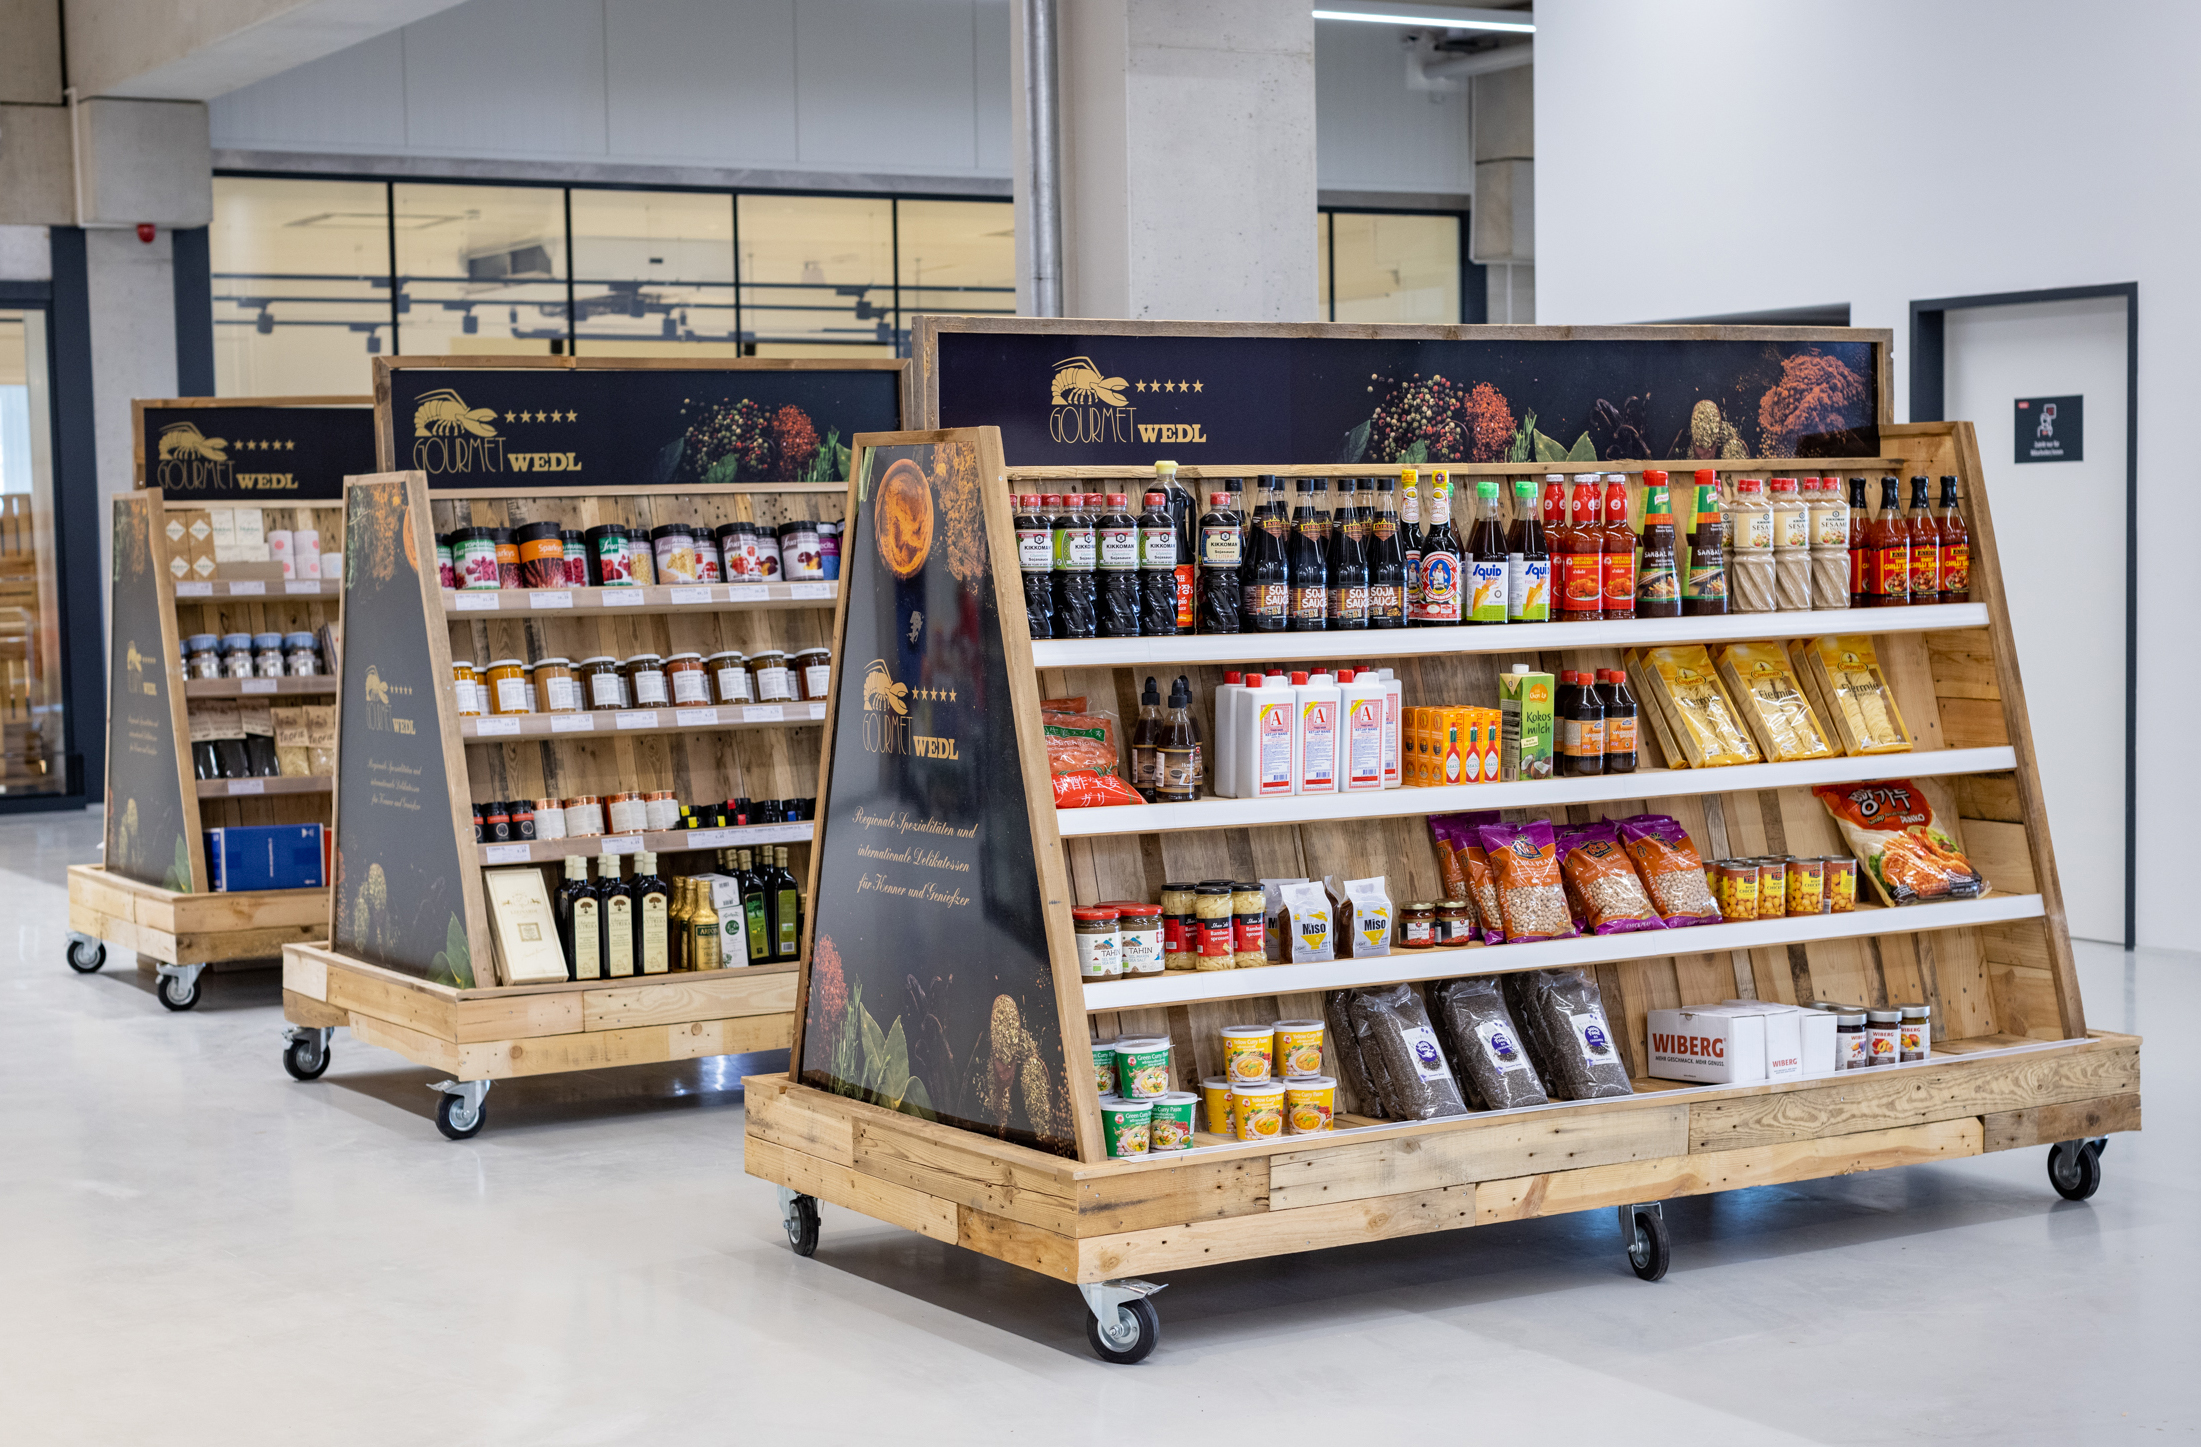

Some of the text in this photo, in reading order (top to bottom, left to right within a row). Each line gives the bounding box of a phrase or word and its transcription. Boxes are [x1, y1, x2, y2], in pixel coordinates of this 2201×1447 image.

[1050, 407, 1207, 444] GOURMET WEDL
[413, 437, 582, 474] GOURMET WEDL
[157, 460, 298, 490] GOURMET WEDL
[538, 543, 563, 553] Sparkys
[1645, 550, 1667, 558] SAMBAL
[1370, 586, 1395, 596] SOJA
[1369, 596, 1399, 607] SAUCE
[1842, 682, 1879, 694] Eiermie
[1271, 710, 1282, 726] A
[1314, 708, 1326, 723] A
[1362, 706, 1373, 721] A
[1526, 711, 1552, 723] Kokos
[392, 718, 416, 735] WEDL
[1528, 722, 1550, 735] milch
[862, 712, 959, 760] GOURMET WEDL
[852, 806, 979, 839] Regionale Spezialitäten und
[1900, 814, 1925, 824] PANKO
[858, 844, 970, 872] internationale Delikatessen
[857, 873, 873, 893] für
[873, 874, 906, 896] Kenner
[908, 884, 927, 899] und
[1646, 869, 1656, 891] CHICK
[1576, 880, 1590, 900] CHICK
[1302, 923, 1326, 935] Miso
[1364, 919, 1386, 930] Miso
[1129, 947, 1153, 955] TAHIN
[1652, 1033, 1724, 1058] WIBERG
[1772, 1058, 1798, 1068] WIBERG
